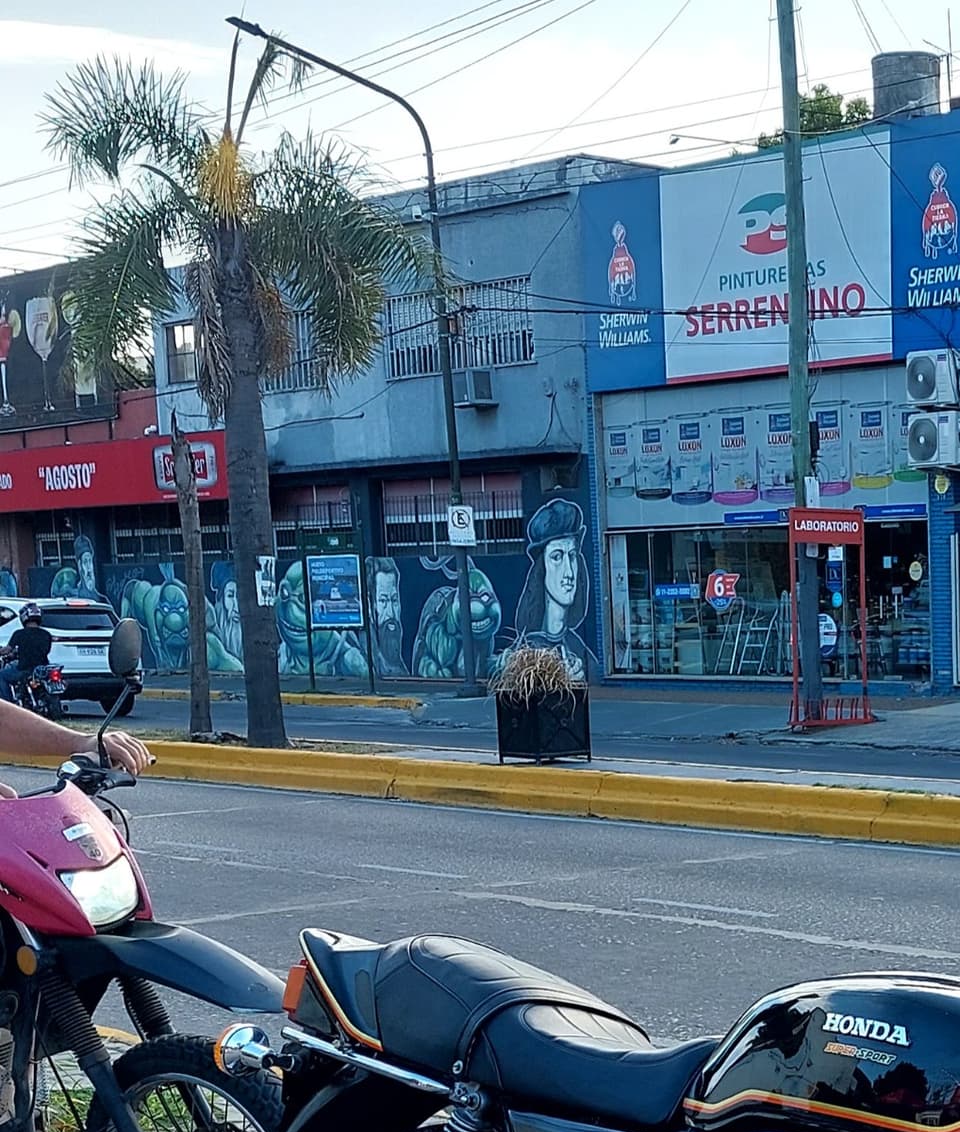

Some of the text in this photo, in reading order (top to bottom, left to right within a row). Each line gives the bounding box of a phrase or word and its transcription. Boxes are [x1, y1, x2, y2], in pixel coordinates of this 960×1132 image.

[719, 259, 826, 292] PINTUREAS
[685, 282, 866, 338] SERRENINO
[599, 312, 648, 330] SHERWIN
[720, 435, 746, 449] LOXON
[859, 427, 884, 439] LOXON
[641, 443, 662, 454] LOXON
[678, 440, 702, 452] LOXON
[794, 520, 859, 533] LABORATORIO
[714, 576, 724, 597] 6
[821, 1011, 911, 1047] HONDA
[824, 1042, 897, 1065] SUPER SPORT
